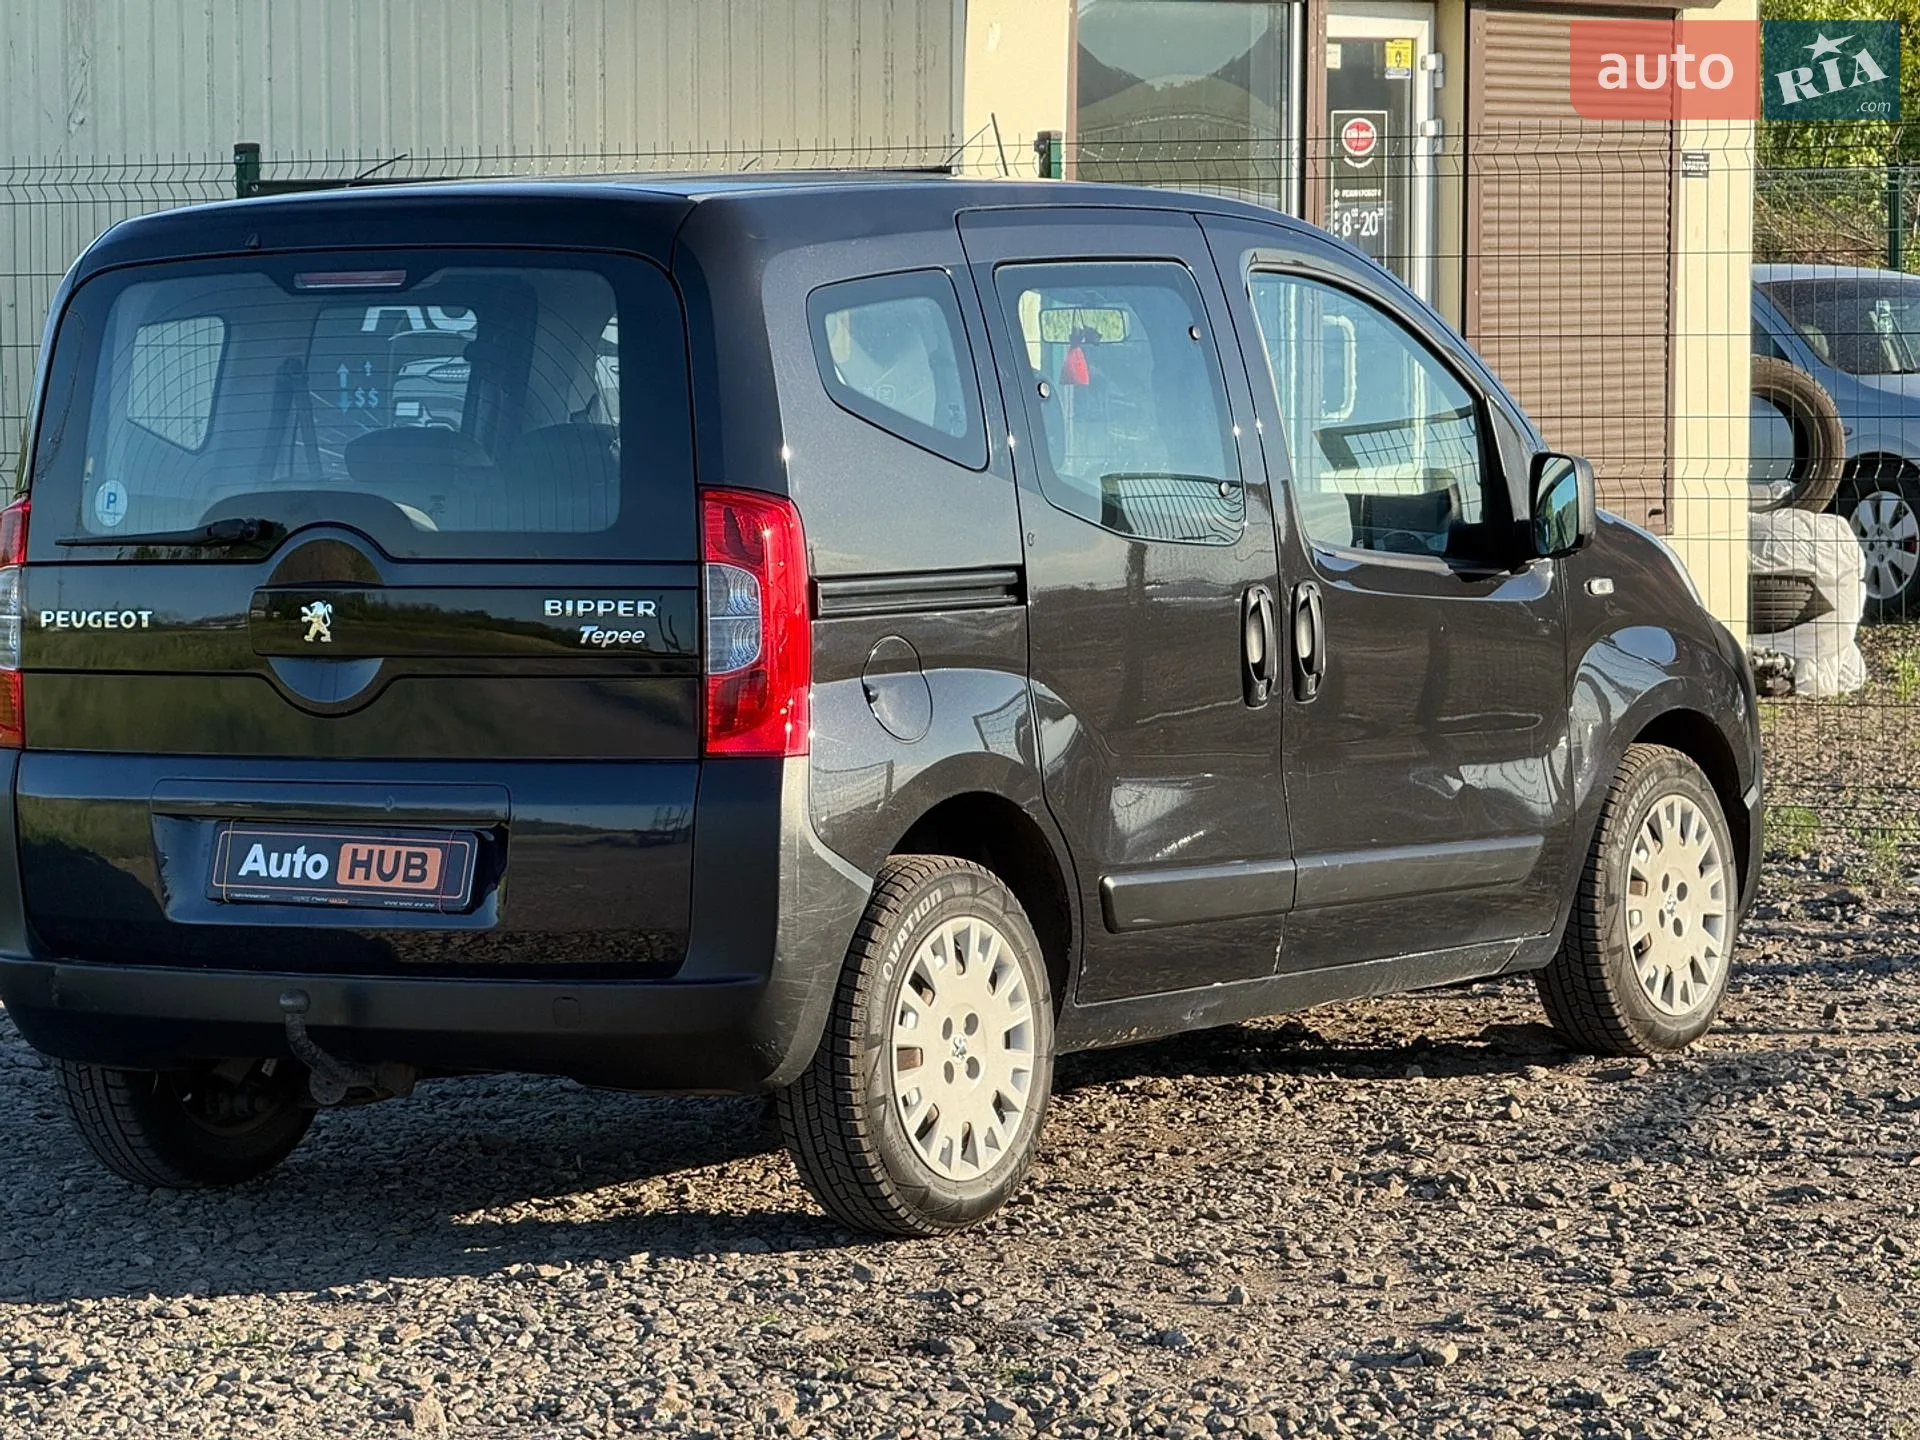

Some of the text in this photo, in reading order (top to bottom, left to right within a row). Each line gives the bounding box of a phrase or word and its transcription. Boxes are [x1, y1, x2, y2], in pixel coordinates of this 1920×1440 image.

[544, 599, 657, 617] BIPPER
[40, 610, 153, 629] PEUGEOT
[579, 625, 645, 648] Tepee
[238, 843, 430, 883] Auto HUB
